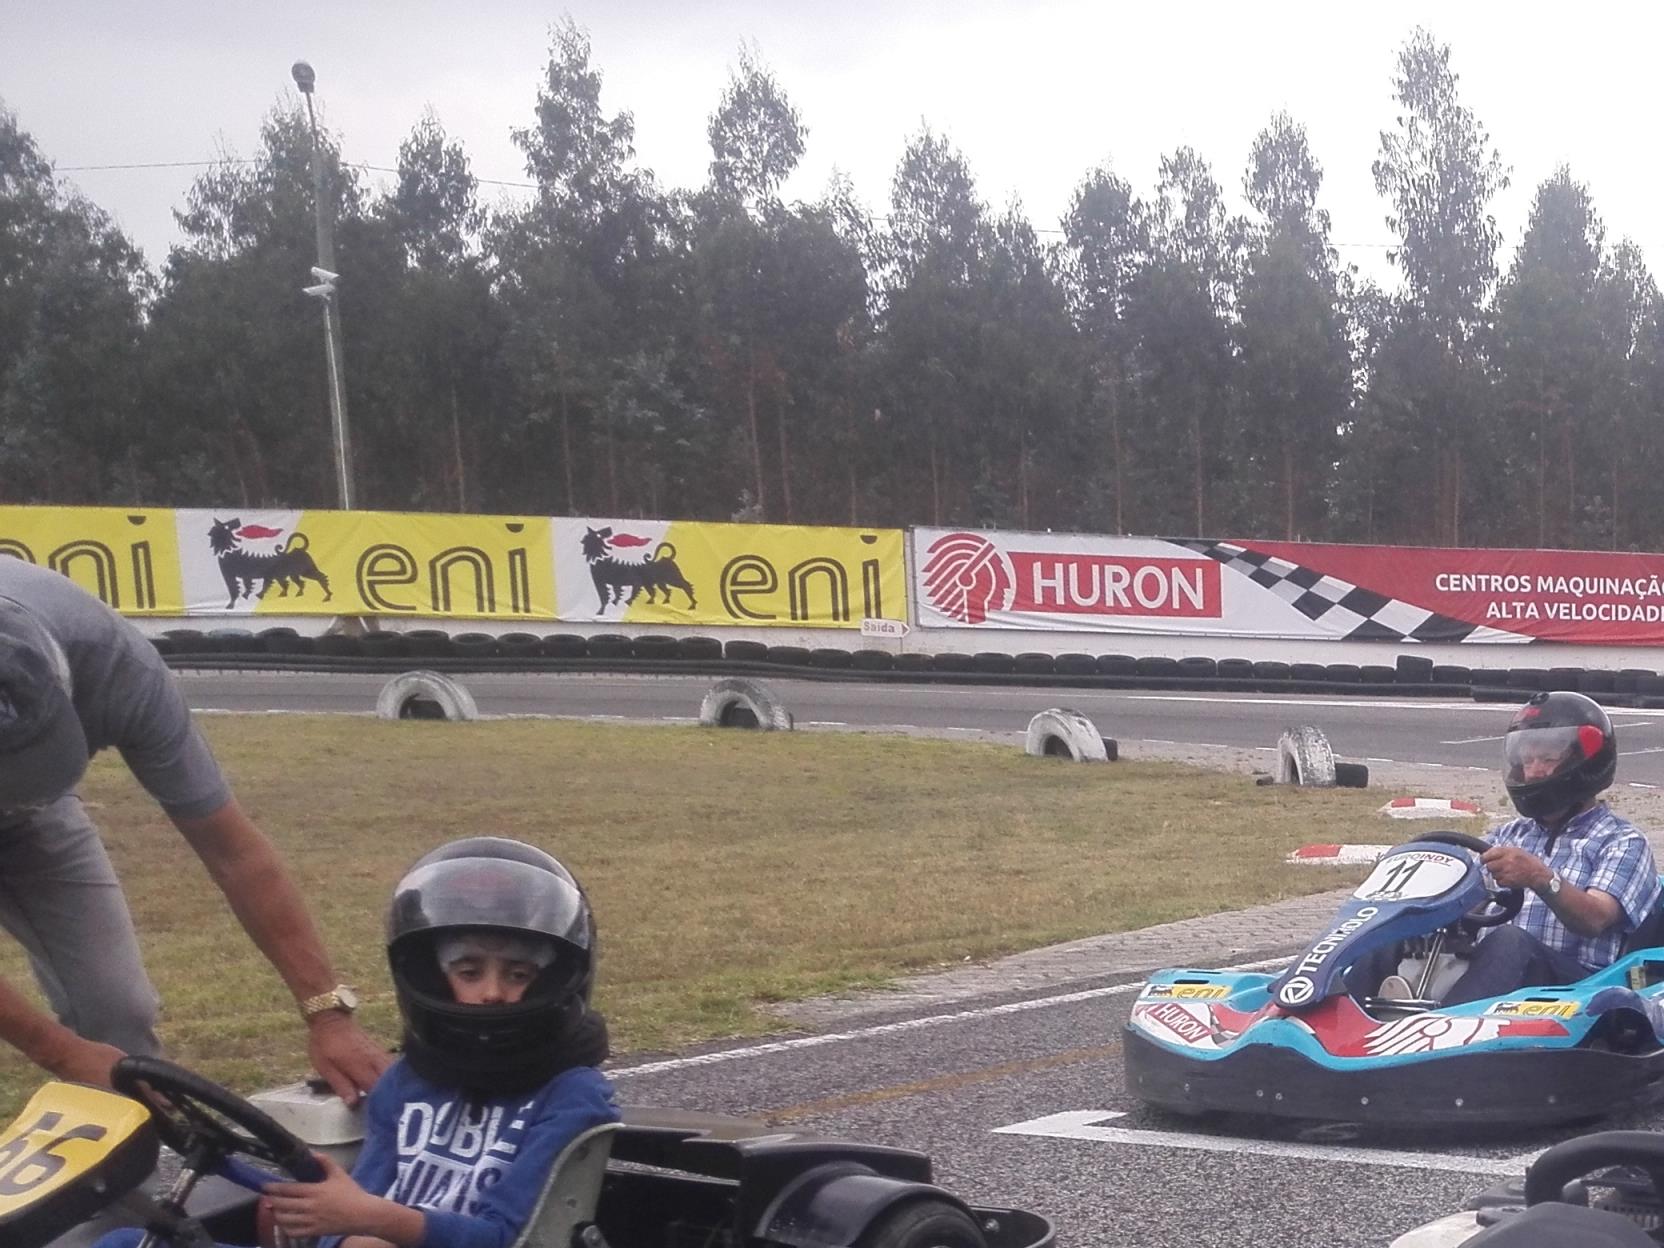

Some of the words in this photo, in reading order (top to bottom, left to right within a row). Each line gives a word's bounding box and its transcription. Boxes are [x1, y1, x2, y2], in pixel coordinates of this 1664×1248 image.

[0, 514, 156, 609] ni
[355, 523, 531, 614] eni
[720, 534, 882, 622] eni
[1032, 560, 1204, 610] HURON
[1435, 573, 1532, 593] CENTROS
[1486, 600, 1540, 620] ALTA
[1379, 859, 1425, 893] 11
[1295, 906, 1379, 976] TECNIROLO
[1177, 984, 1226, 999] eni
[1521, 1001, 1574, 1018] eni
[1154, 1003, 1208, 1041] HURON
